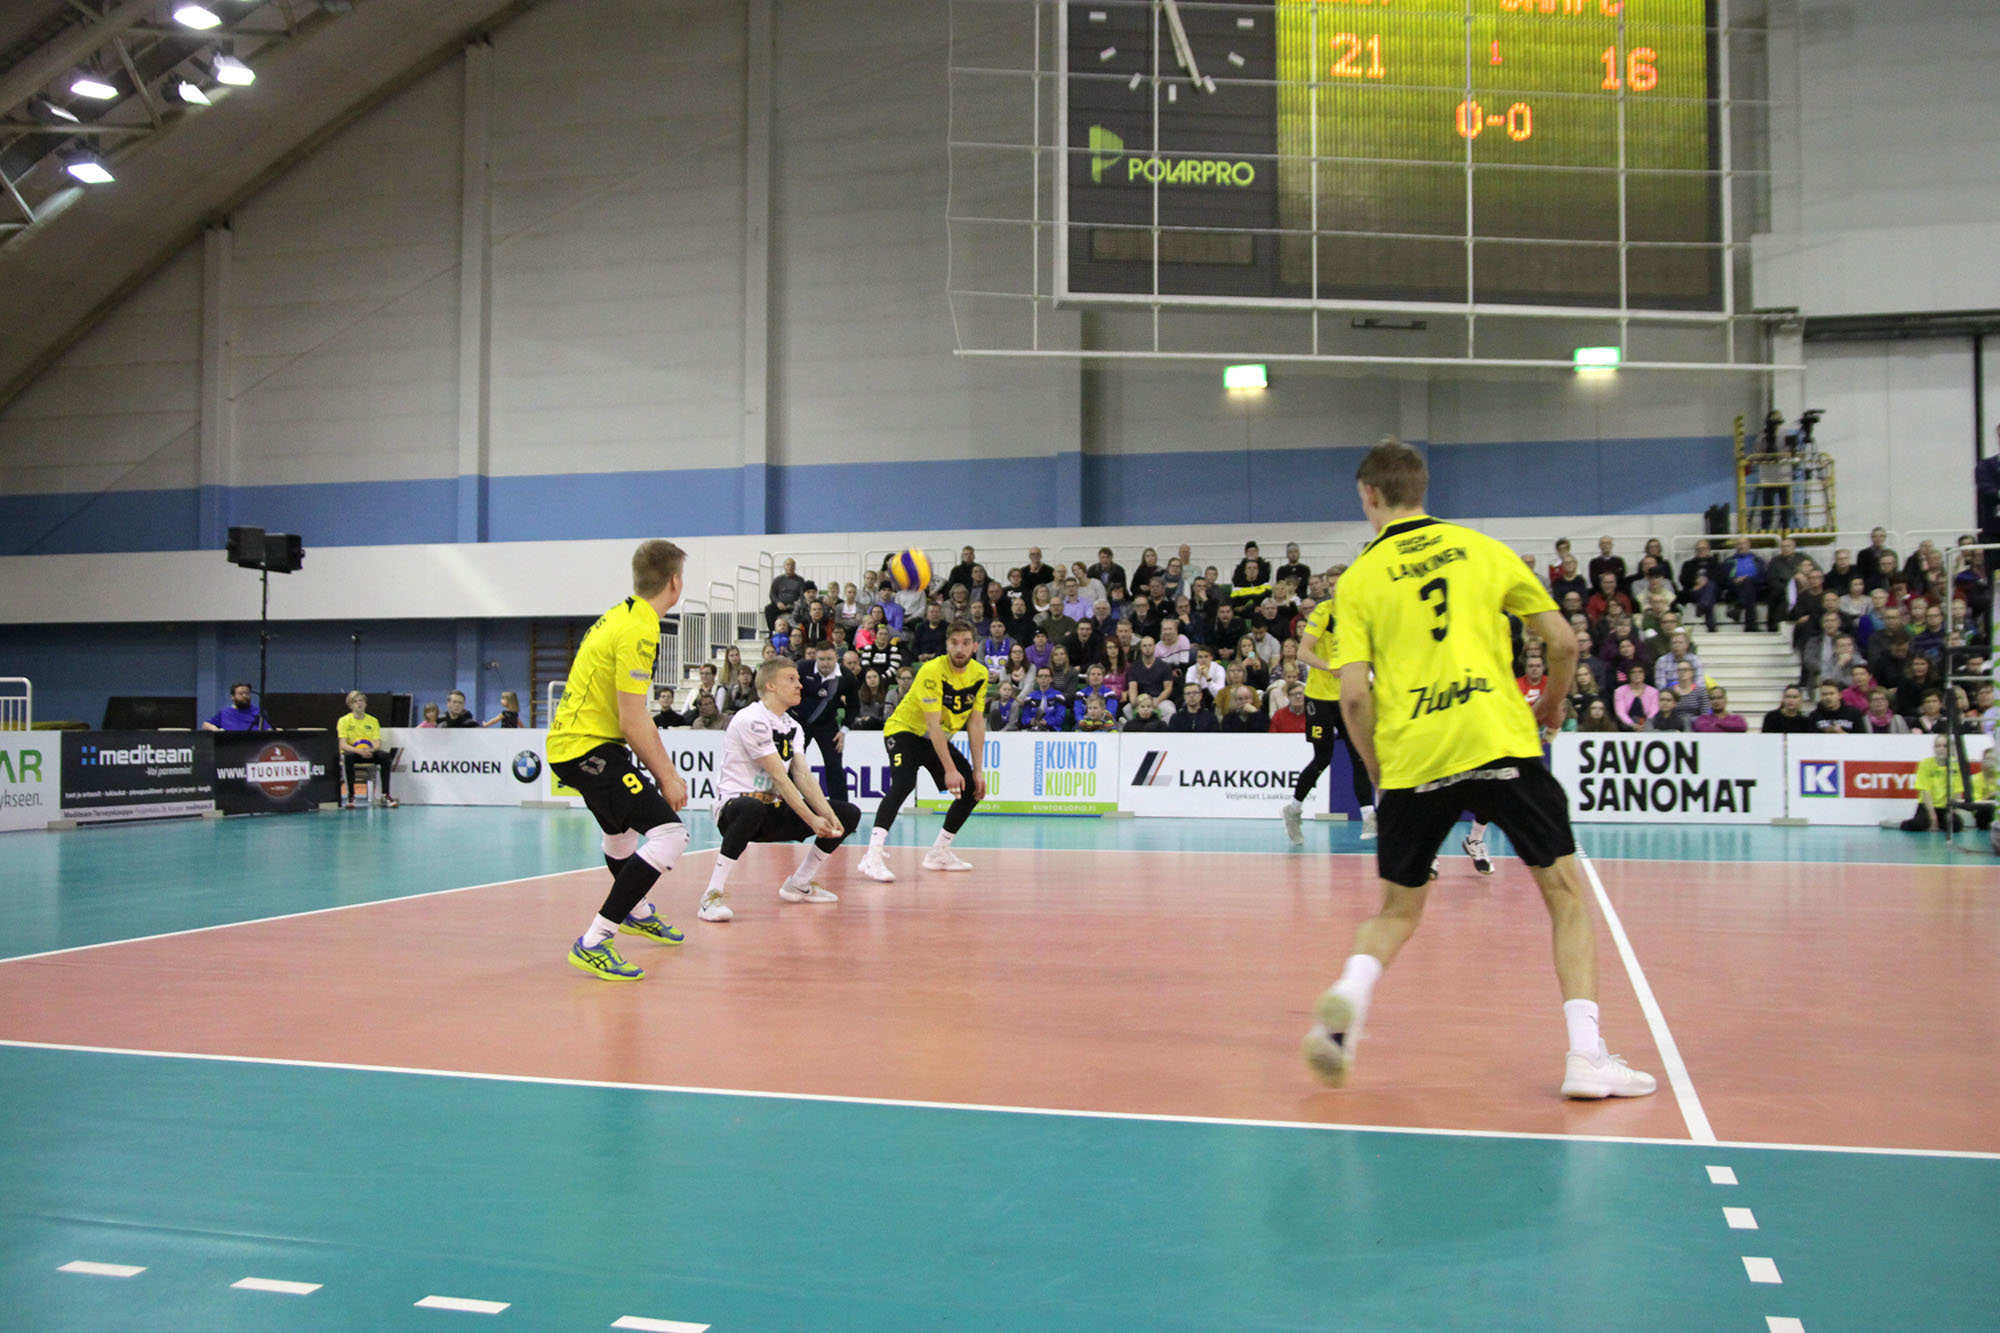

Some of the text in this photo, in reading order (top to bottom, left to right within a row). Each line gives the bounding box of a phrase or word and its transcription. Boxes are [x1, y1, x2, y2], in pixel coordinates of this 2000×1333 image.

[1330, 32, 1386, 78] 21
[1490, 39, 1503, 65] 1
[1600, 45, 1658, 91] 16
[1456, 100, 1532, 141] 0-0
[1128, 157, 1255, 187] POLARPRO
[1420, 577, 1449, 642] 3
[953, 695, 962, 711] 5
[1311, 725, 1323, 739] 12
[99, 744, 193, 766] mediteam
[411, 760, 502, 774] LAAKKONEN
[894, 753, 902, 767] 5
[1046, 741, 1097, 769] KUNTO
[1579, 740, 1698, 775] SAVON
[622, 772, 644, 795] 9
[1045, 772, 1097, 797] KUOPIO
[1179, 769, 1317, 788] LAAKKONE
[1579, 778, 1757, 813] SANOMAT
